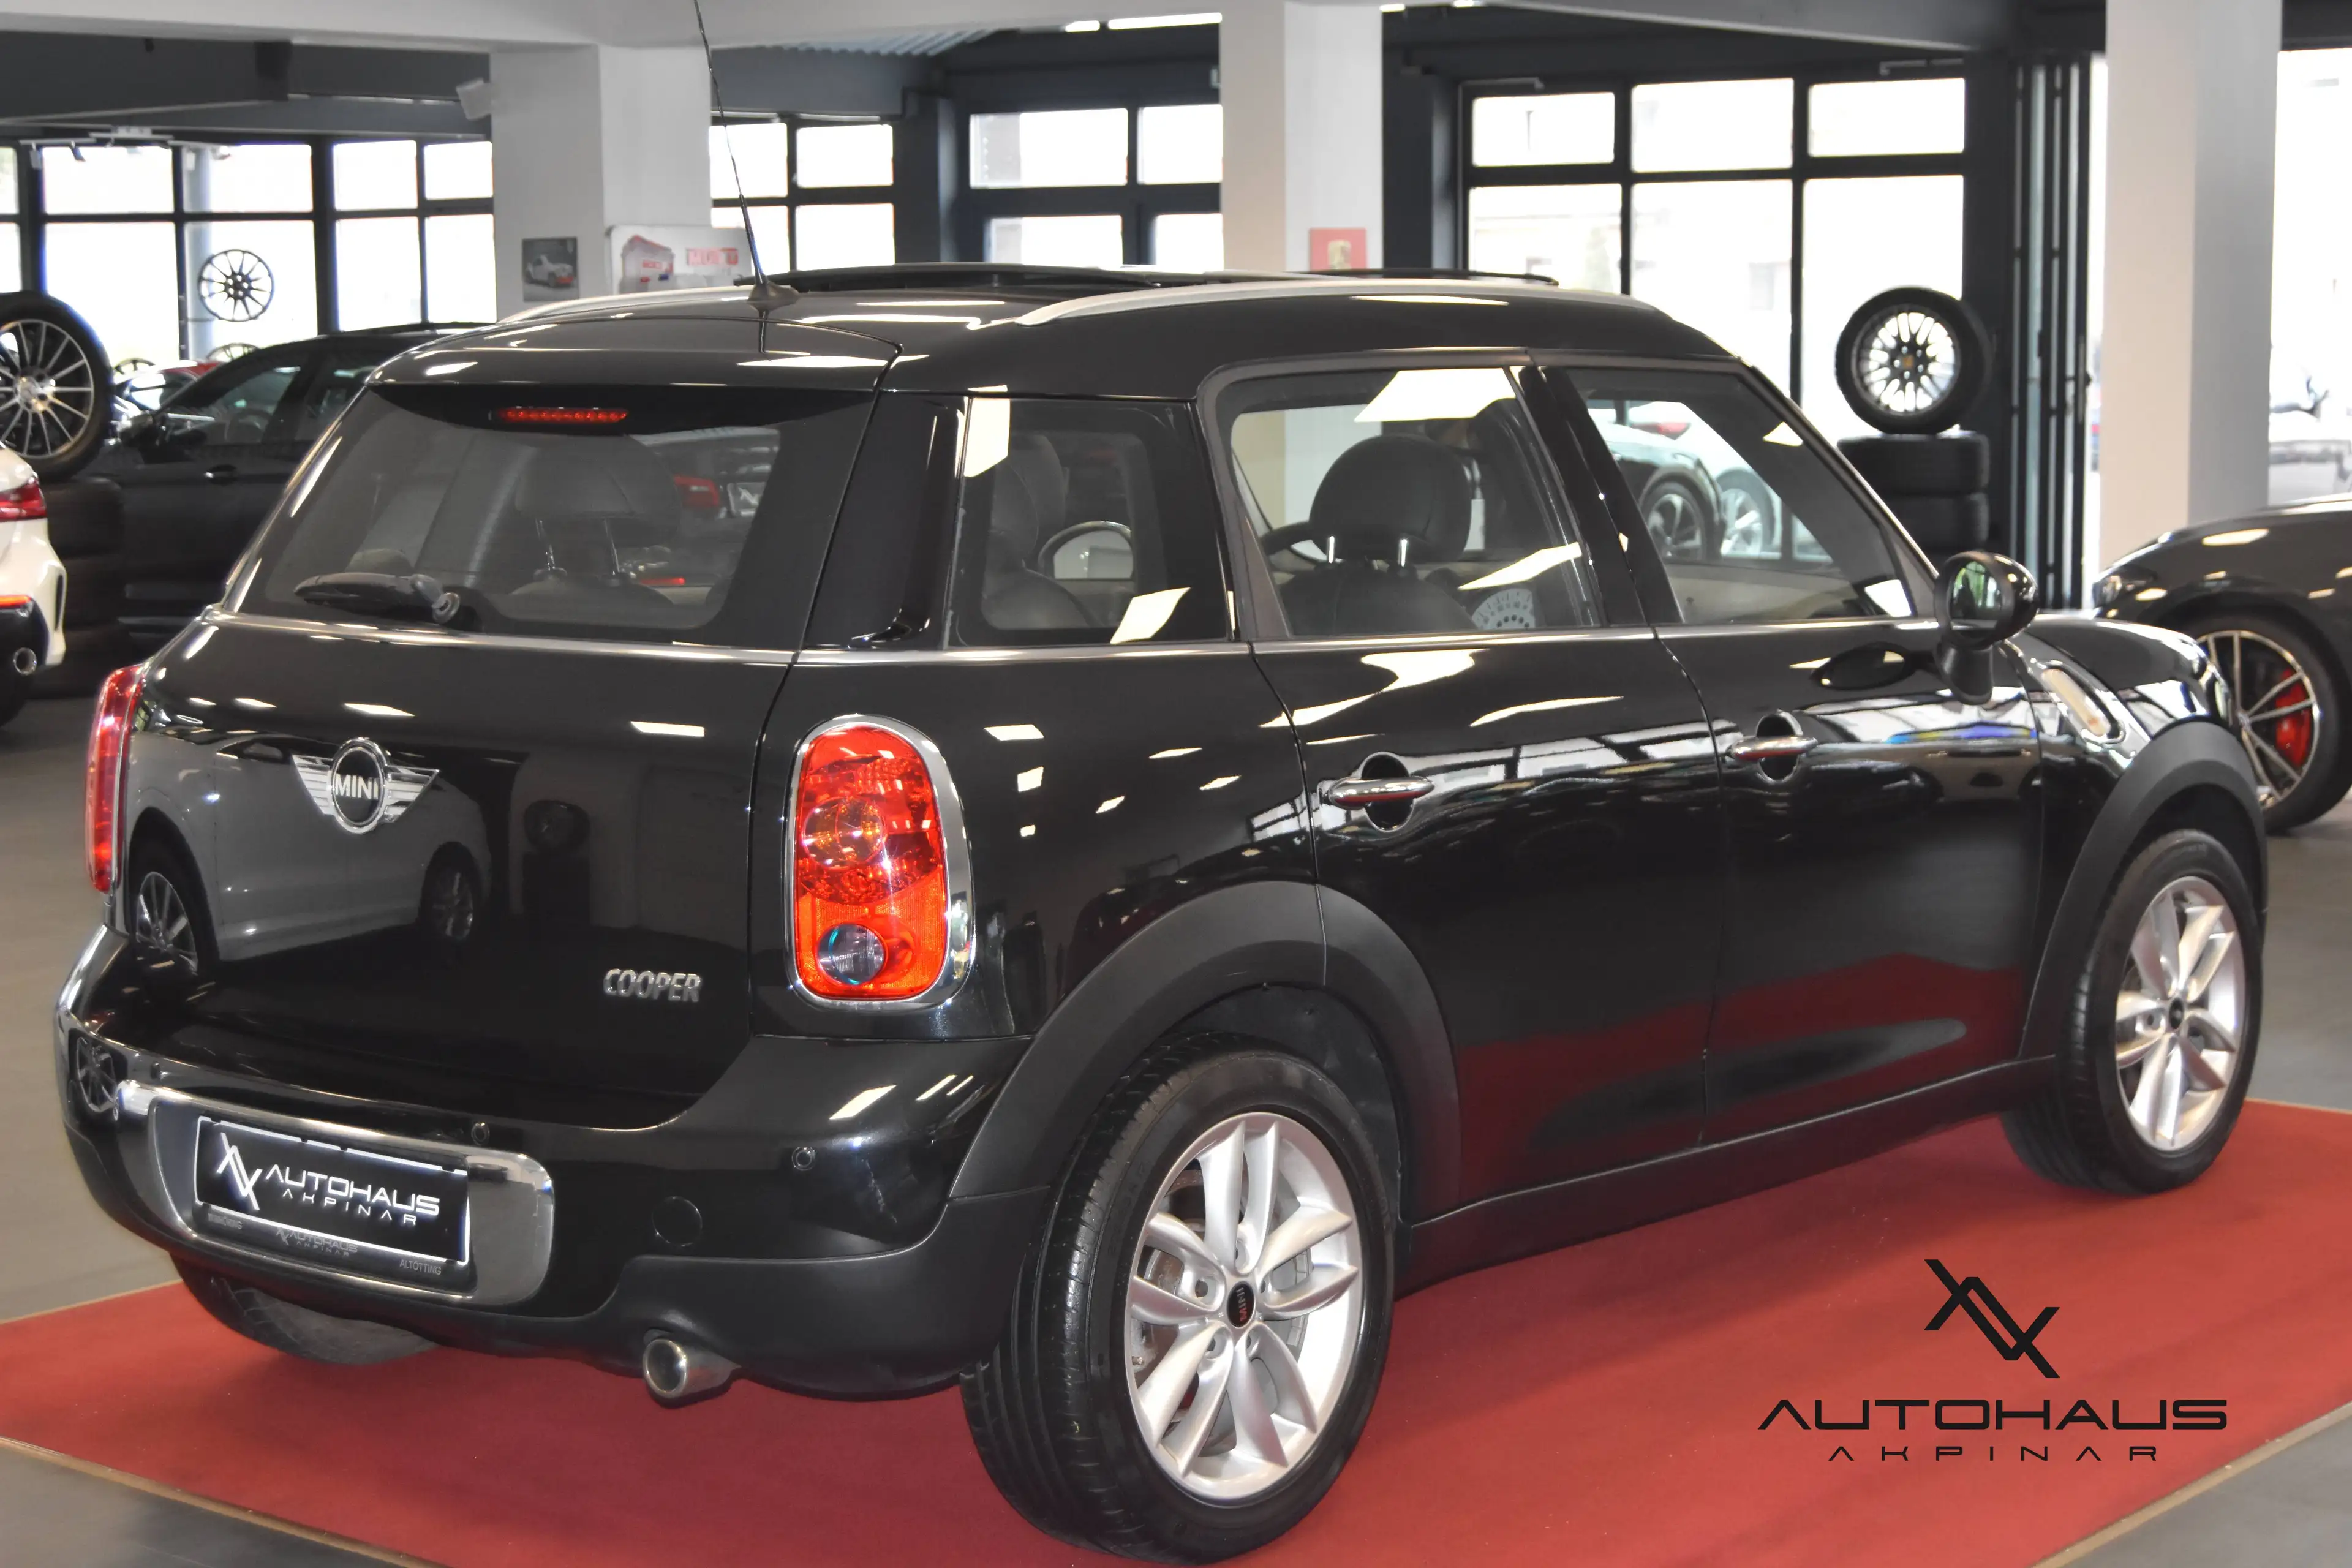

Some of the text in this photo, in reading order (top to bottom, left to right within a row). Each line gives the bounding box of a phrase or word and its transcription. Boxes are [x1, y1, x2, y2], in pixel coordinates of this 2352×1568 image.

[335, 773, 381, 800] MINI
[603, 968, 701, 1002] COOPER
[266, 1164, 440, 1216] AUTOHAUS
[282, 1188, 417, 1226] AKPINAR
[1236, 1287, 1248, 1322] MINI
